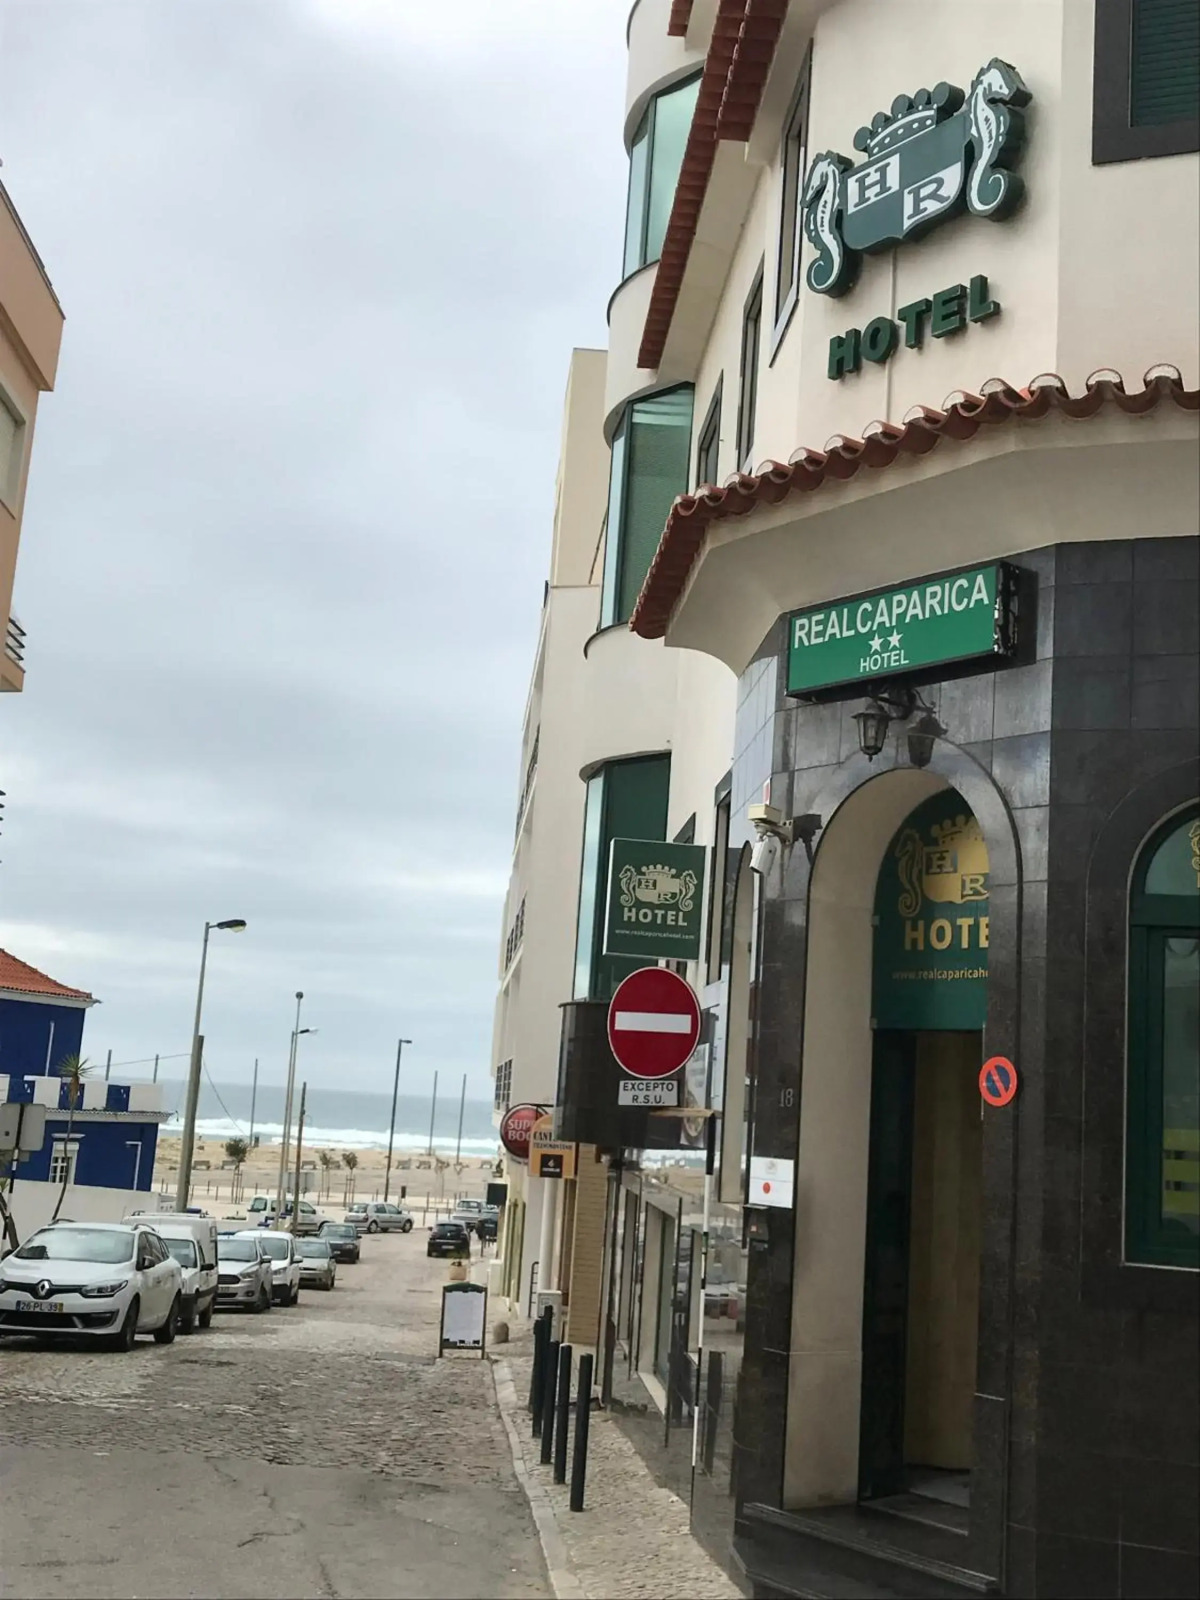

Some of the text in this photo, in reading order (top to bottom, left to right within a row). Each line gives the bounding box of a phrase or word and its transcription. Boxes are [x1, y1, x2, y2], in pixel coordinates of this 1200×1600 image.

[853, 161, 892, 208] H
[906, 175, 951, 220] R
[827, 274, 1000, 380] HOTEL
[860, 650, 909, 673] HOTEL
[929, 852, 953, 873] H
[639, 879, 655, 890] H
[963, 875, 988, 896] R
[659, 892, 673, 902] R
[623, 907, 688, 926] HOTEL
[904, 917, 989, 950] HOTE
[622, 1081, 674, 1092] EXCEPTO
[631, 1094, 665, 1105] R.S.U.
[507, 1118, 530, 1130] SUP
